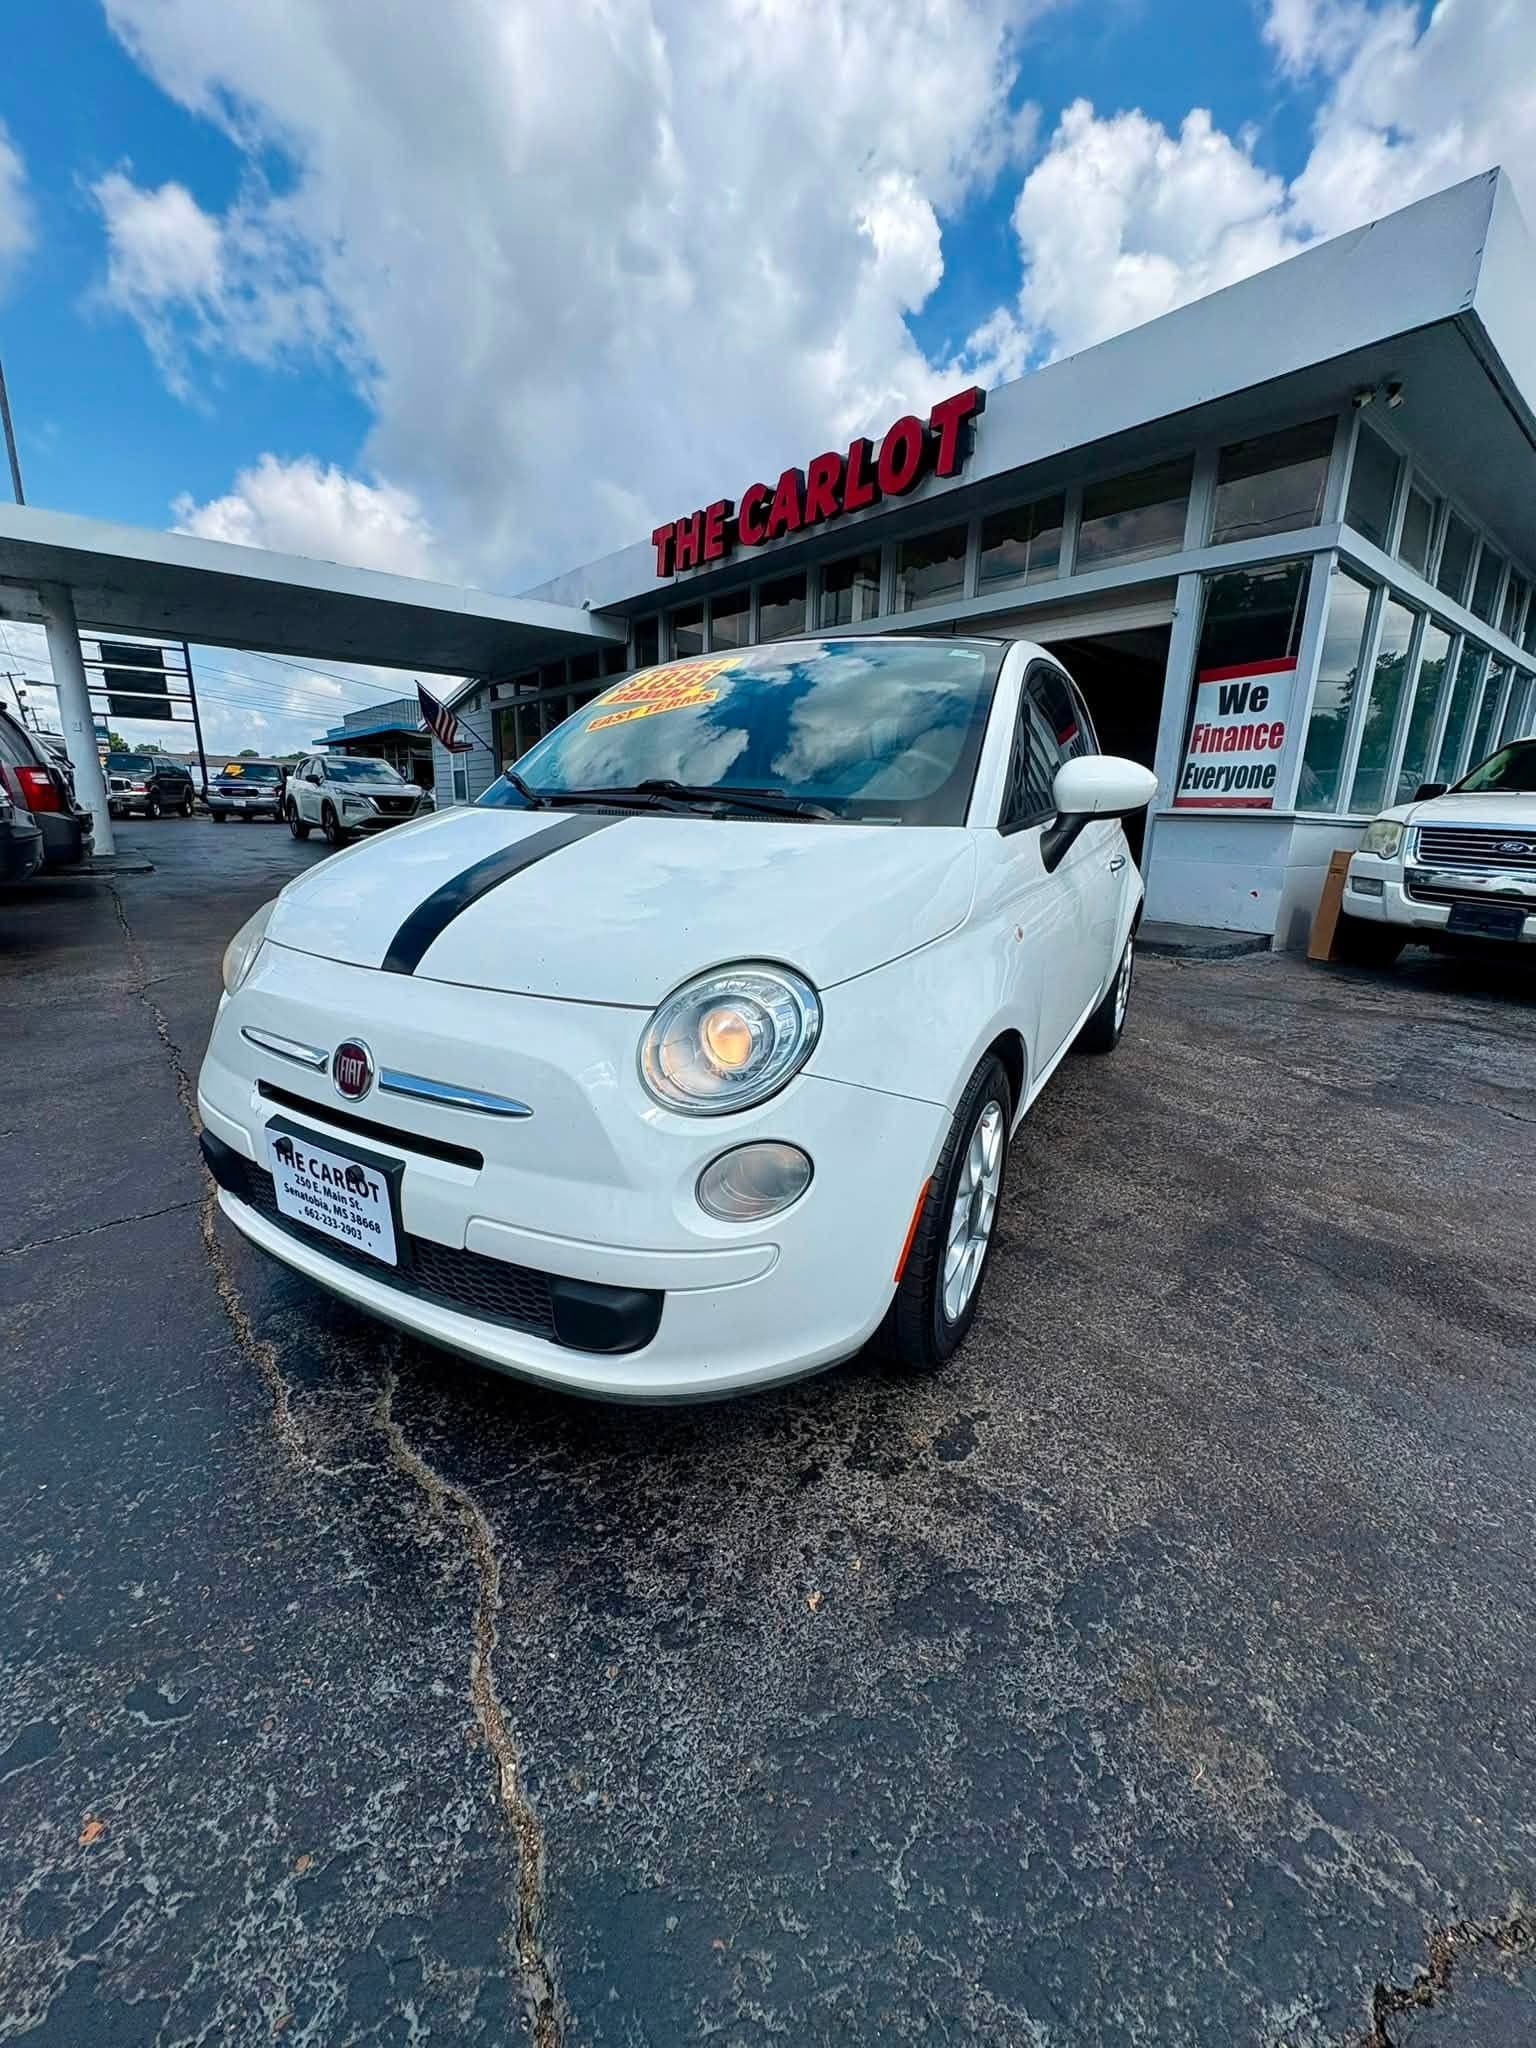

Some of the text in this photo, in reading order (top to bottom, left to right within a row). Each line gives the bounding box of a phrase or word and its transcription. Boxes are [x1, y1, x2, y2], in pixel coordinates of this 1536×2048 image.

[652, 386, 986, 577] THE CARLOT
[1218, 682, 1270, 716] We
[1189, 721, 1286, 754] Finance
[1181, 762, 1277, 793] Everyone
[340, 1055, 365, 1087] FIAT
[283, 1182, 382, 1235] Senatobia, MS 38668
[294, 1173, 313, 1190] 250
[323, 1186, 348, 1205] Main
[349, 1196, 363, 1212] St.
[304, 1205, 363, 1241] 662-233-2903
